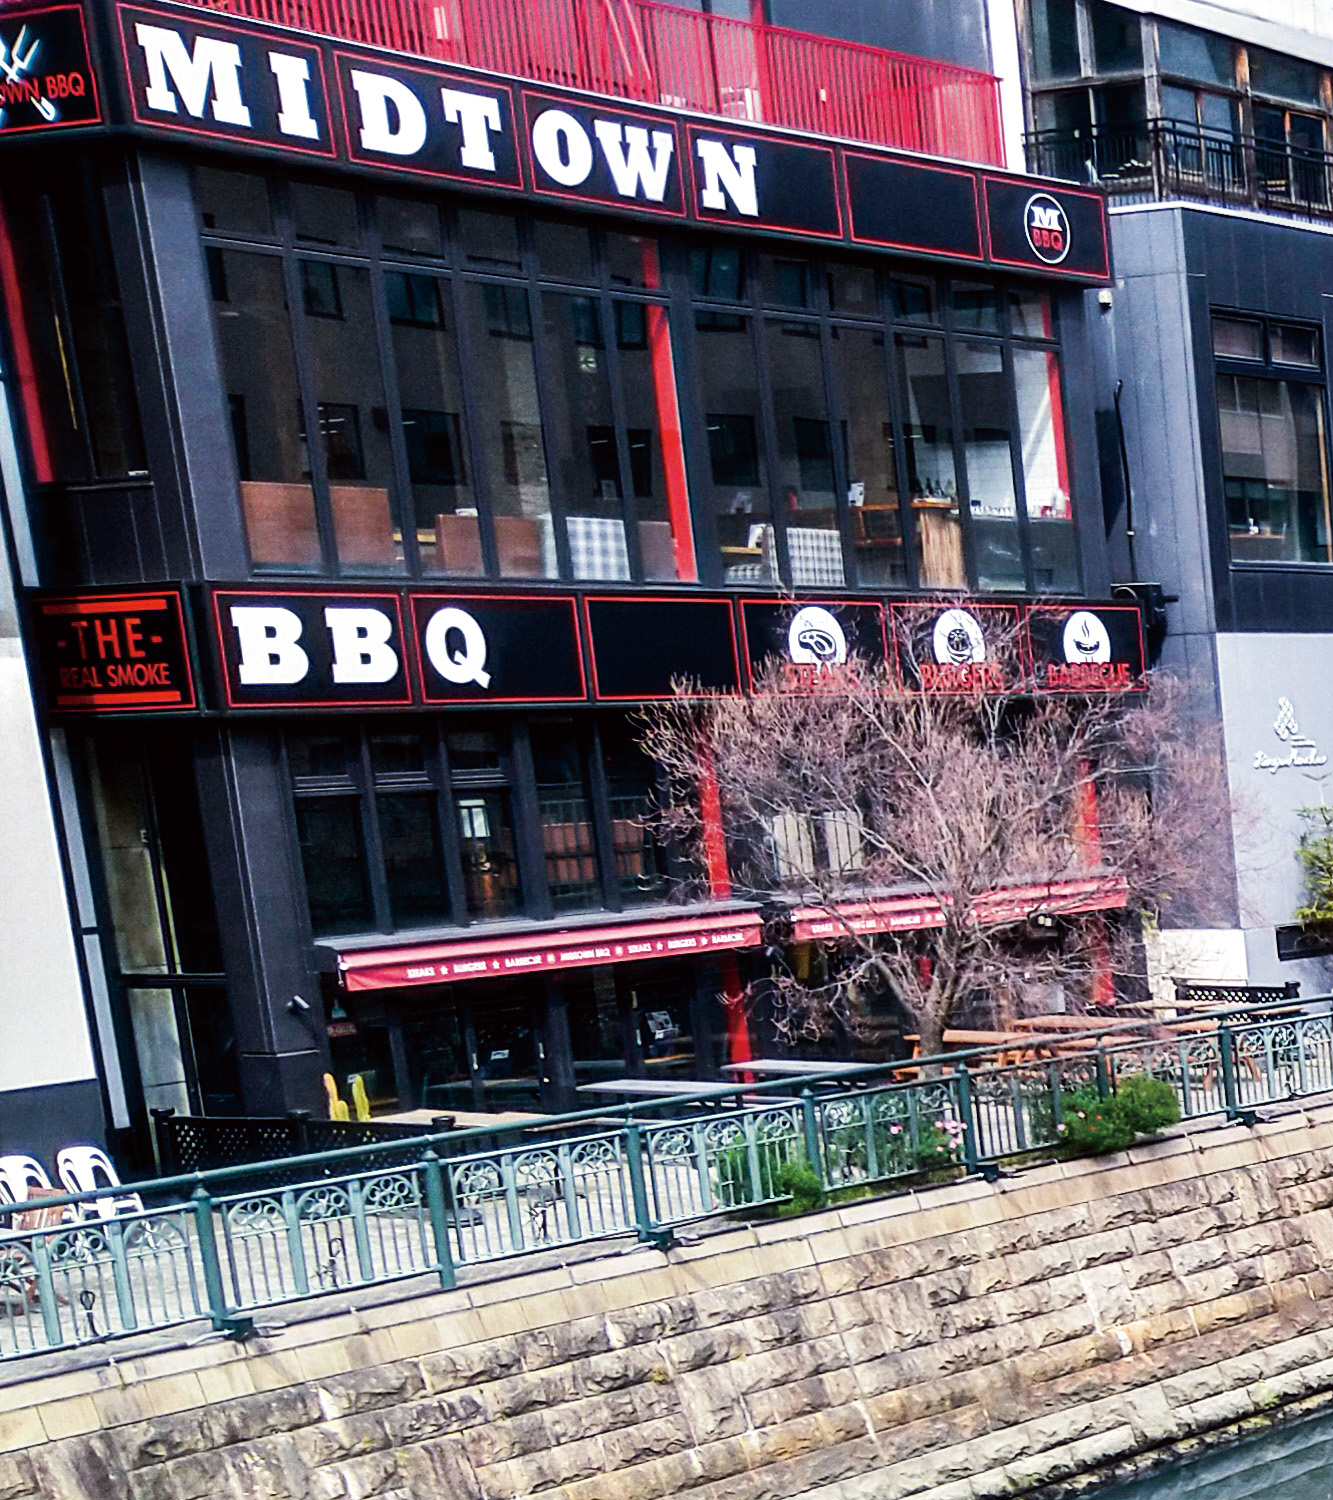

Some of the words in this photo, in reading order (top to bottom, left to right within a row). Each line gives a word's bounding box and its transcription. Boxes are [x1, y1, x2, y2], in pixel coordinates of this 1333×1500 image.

[45, 71, 86, 99] BBQ
[135, 23, 760, 217] MIDTOWN
[1031, 206, 1063, 231] M
[1032, 228, 1063, 251] BBQ
[73, 617, 146, 660] THE
[230, 606, 492, 689] BBQ
[60, 666, 102, 688] REAL
[108, 663, 171, 687] SMOKE
